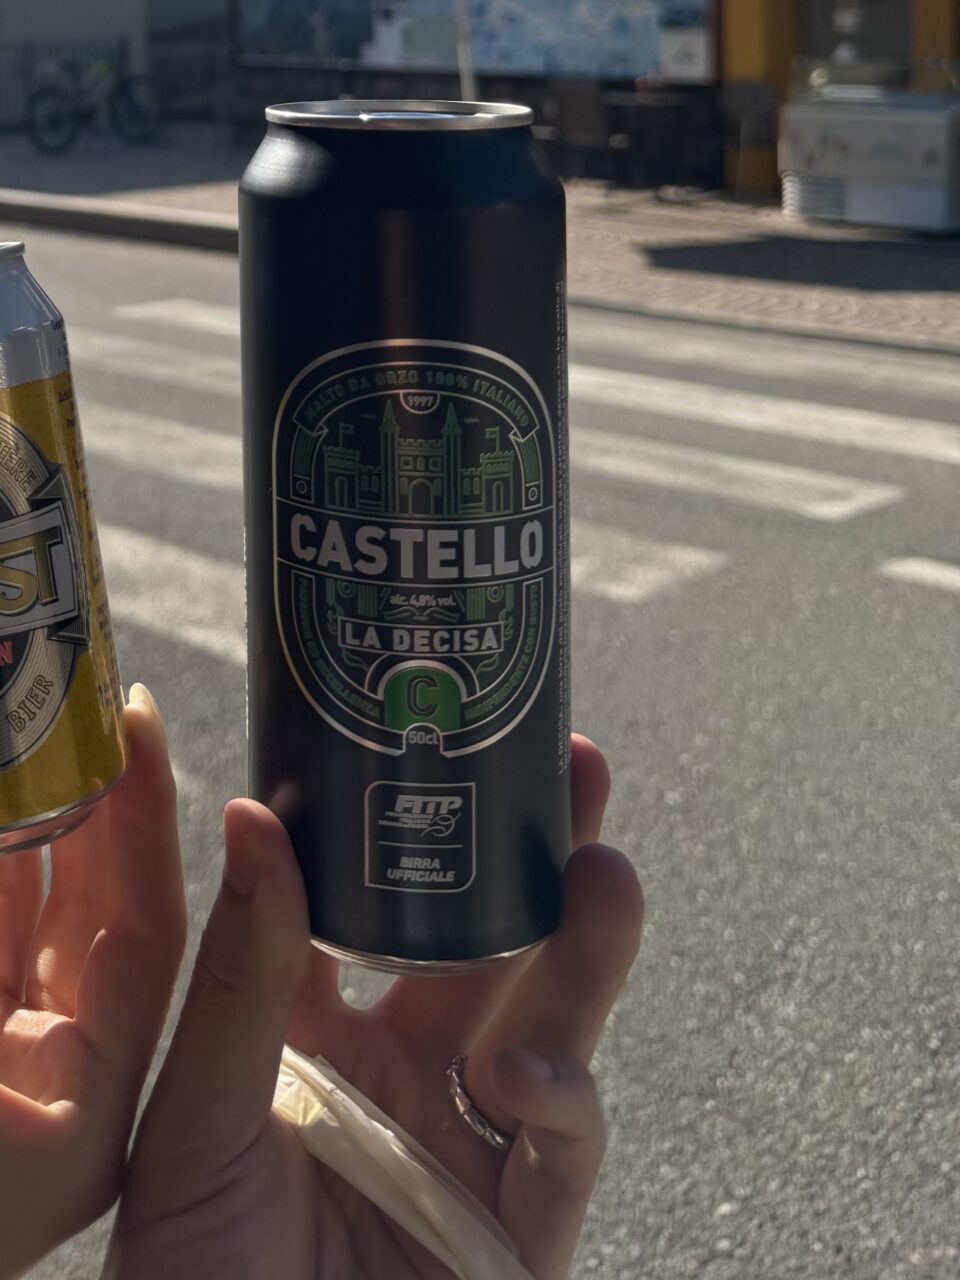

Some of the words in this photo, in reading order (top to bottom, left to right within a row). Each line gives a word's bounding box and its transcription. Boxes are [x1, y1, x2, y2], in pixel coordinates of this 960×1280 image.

[304, 382, 346, 420] MALTO
[348, 374, 371, 392] DA
[375, 369, 419, 386] ORZO
[425, 370, 469, 390] 100%
[472, 376, 532, 429] ITALIANO
[406, 394, 434, 408] 1997
[290, 512, 544, 580] CASTELLO
[389, 593, 408, 606] alc.
[409, 594, 437, 607] 4,8%
[437, 594, 457, 606] vol.
[345, 622, 383, 649] LA
[392, 626, 500, 653] DECISA
[4, 674, 55, 734] BIER
[405, 674, 439, 718] C
[408, 730, 438, 745] 50cl
[399, 856, 440, 869] BIRRA
[386, 868, 455, 881] UFFICIALE
